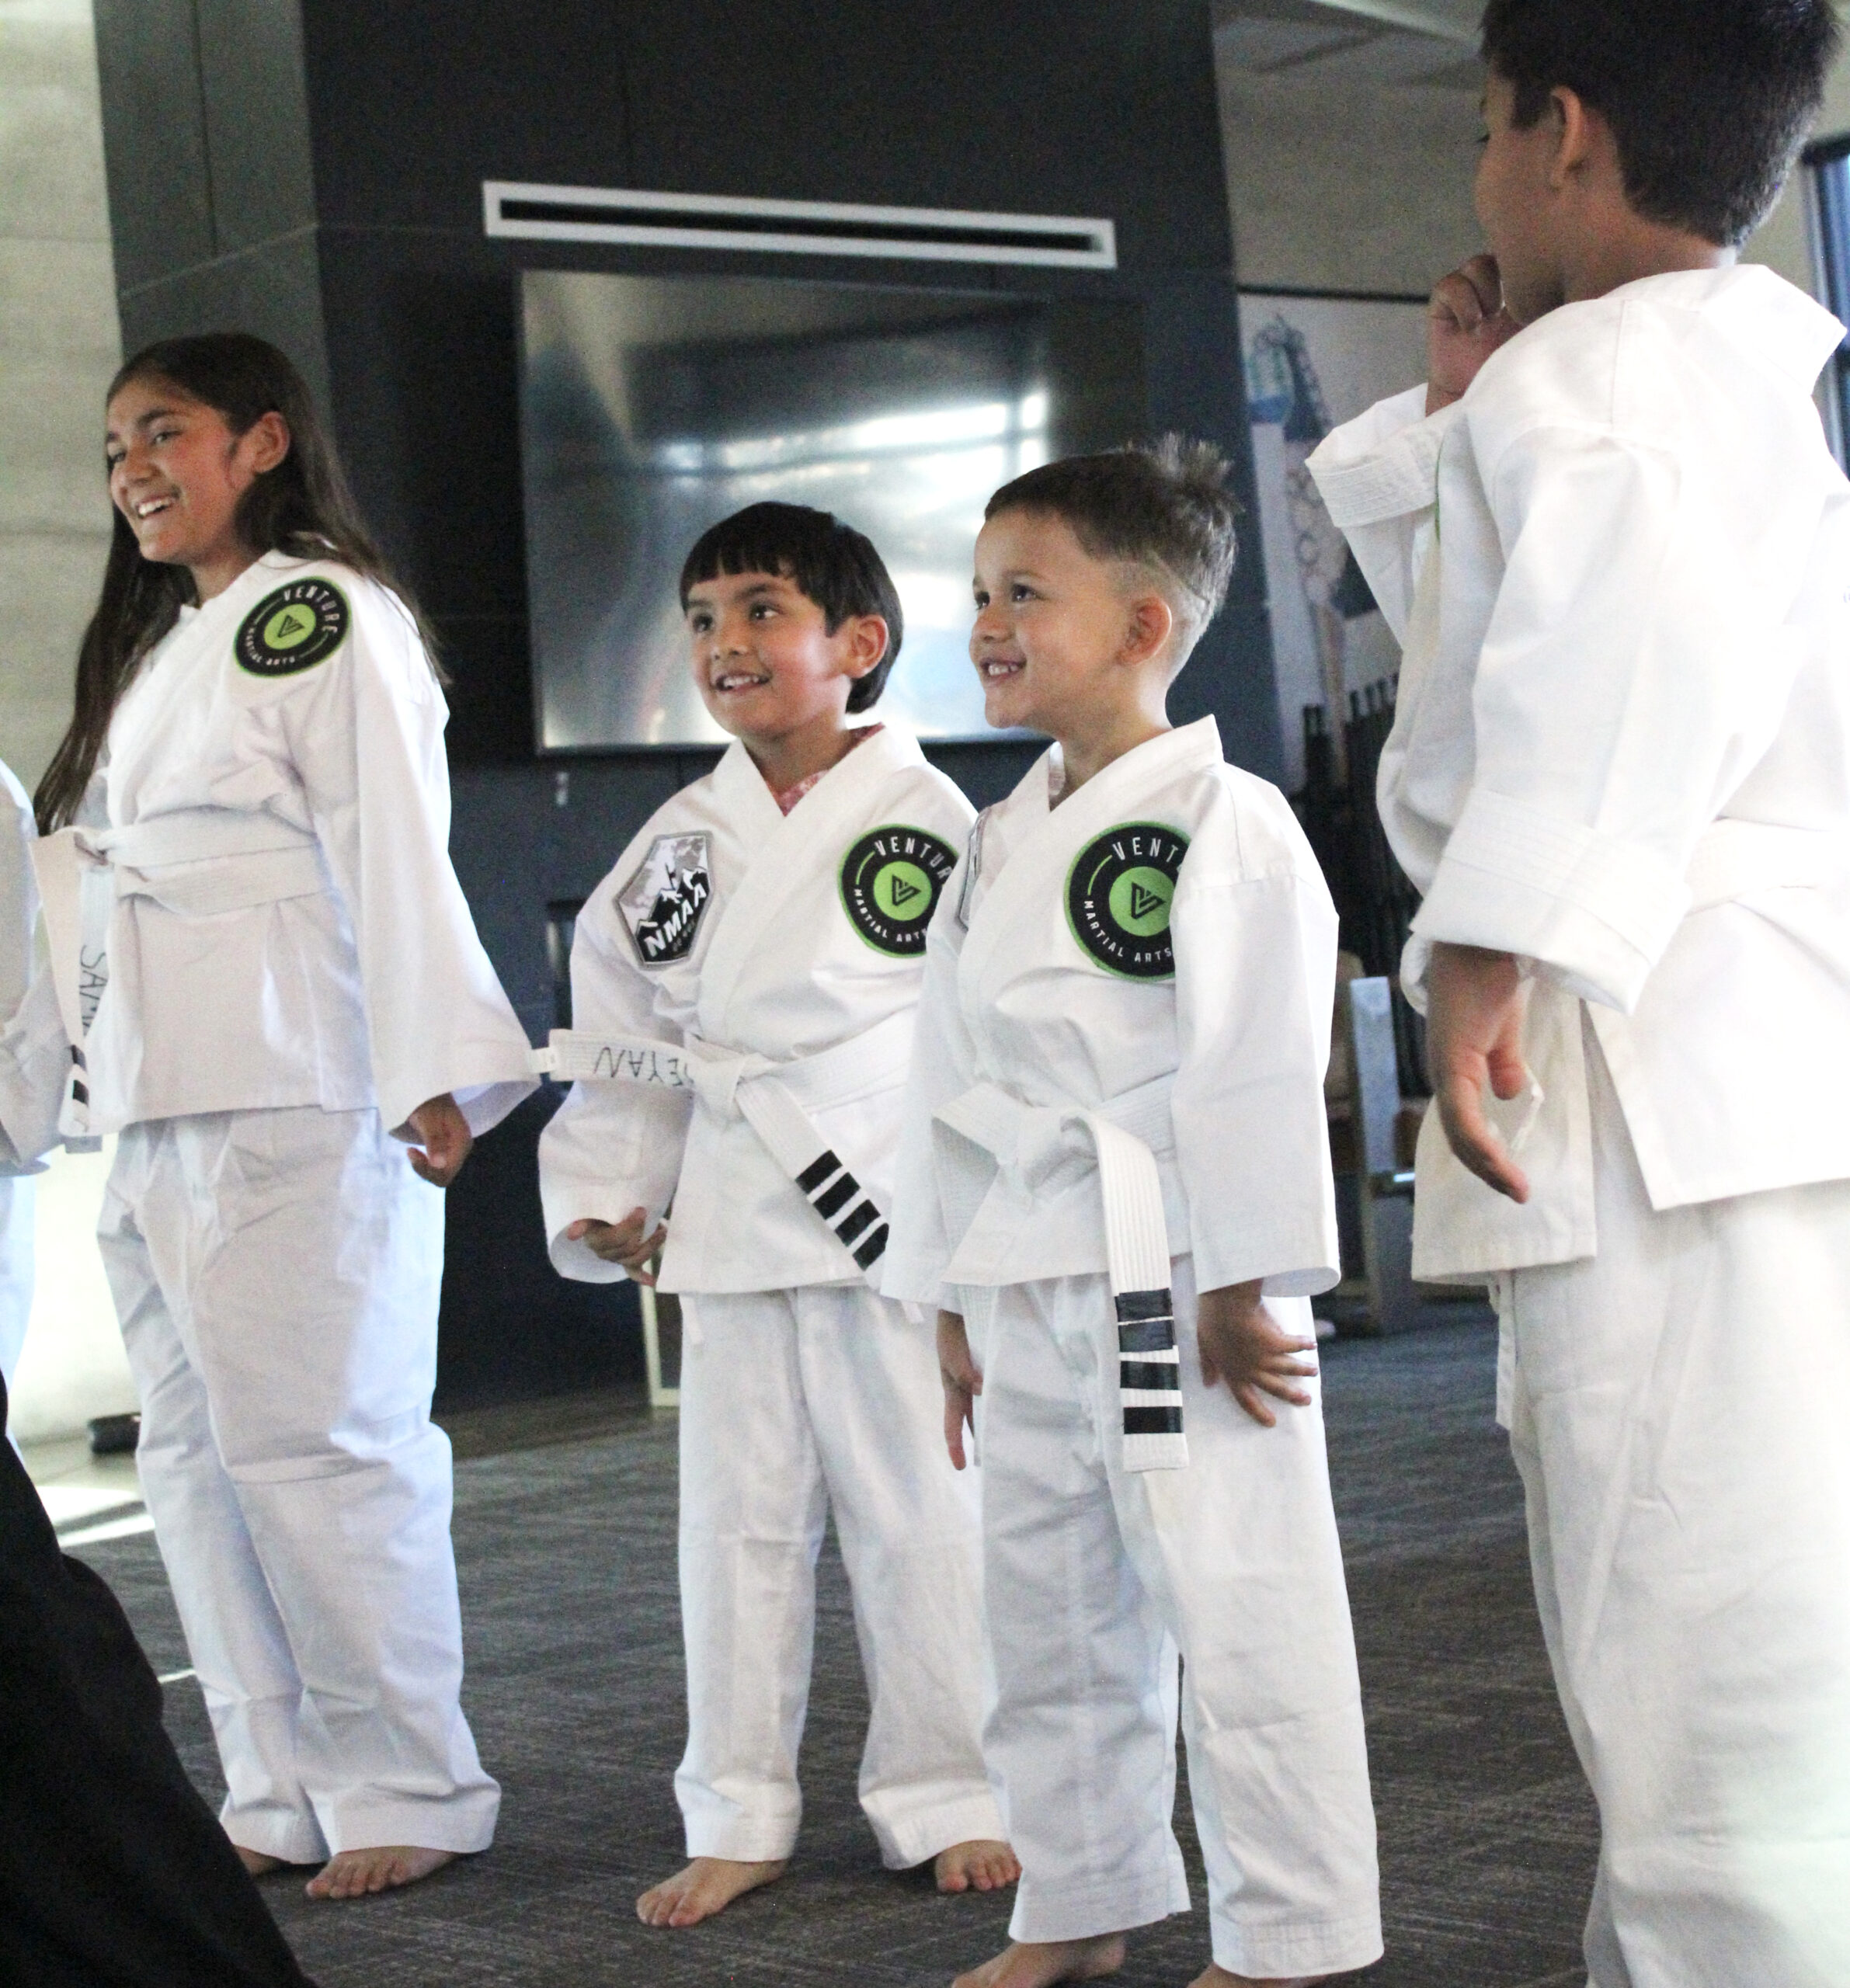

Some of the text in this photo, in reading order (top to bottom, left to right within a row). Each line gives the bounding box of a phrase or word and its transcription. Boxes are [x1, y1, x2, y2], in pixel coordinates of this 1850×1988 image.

[875, 836, 953, 879] VENTUR
[1112, 836, 1181, 872] VENT
[644, 883, 707, 957] NMAA
[854, 888, 888, 939] MARTIAL
[1084, 900, 1173, 963] MARTIAL ARTS
